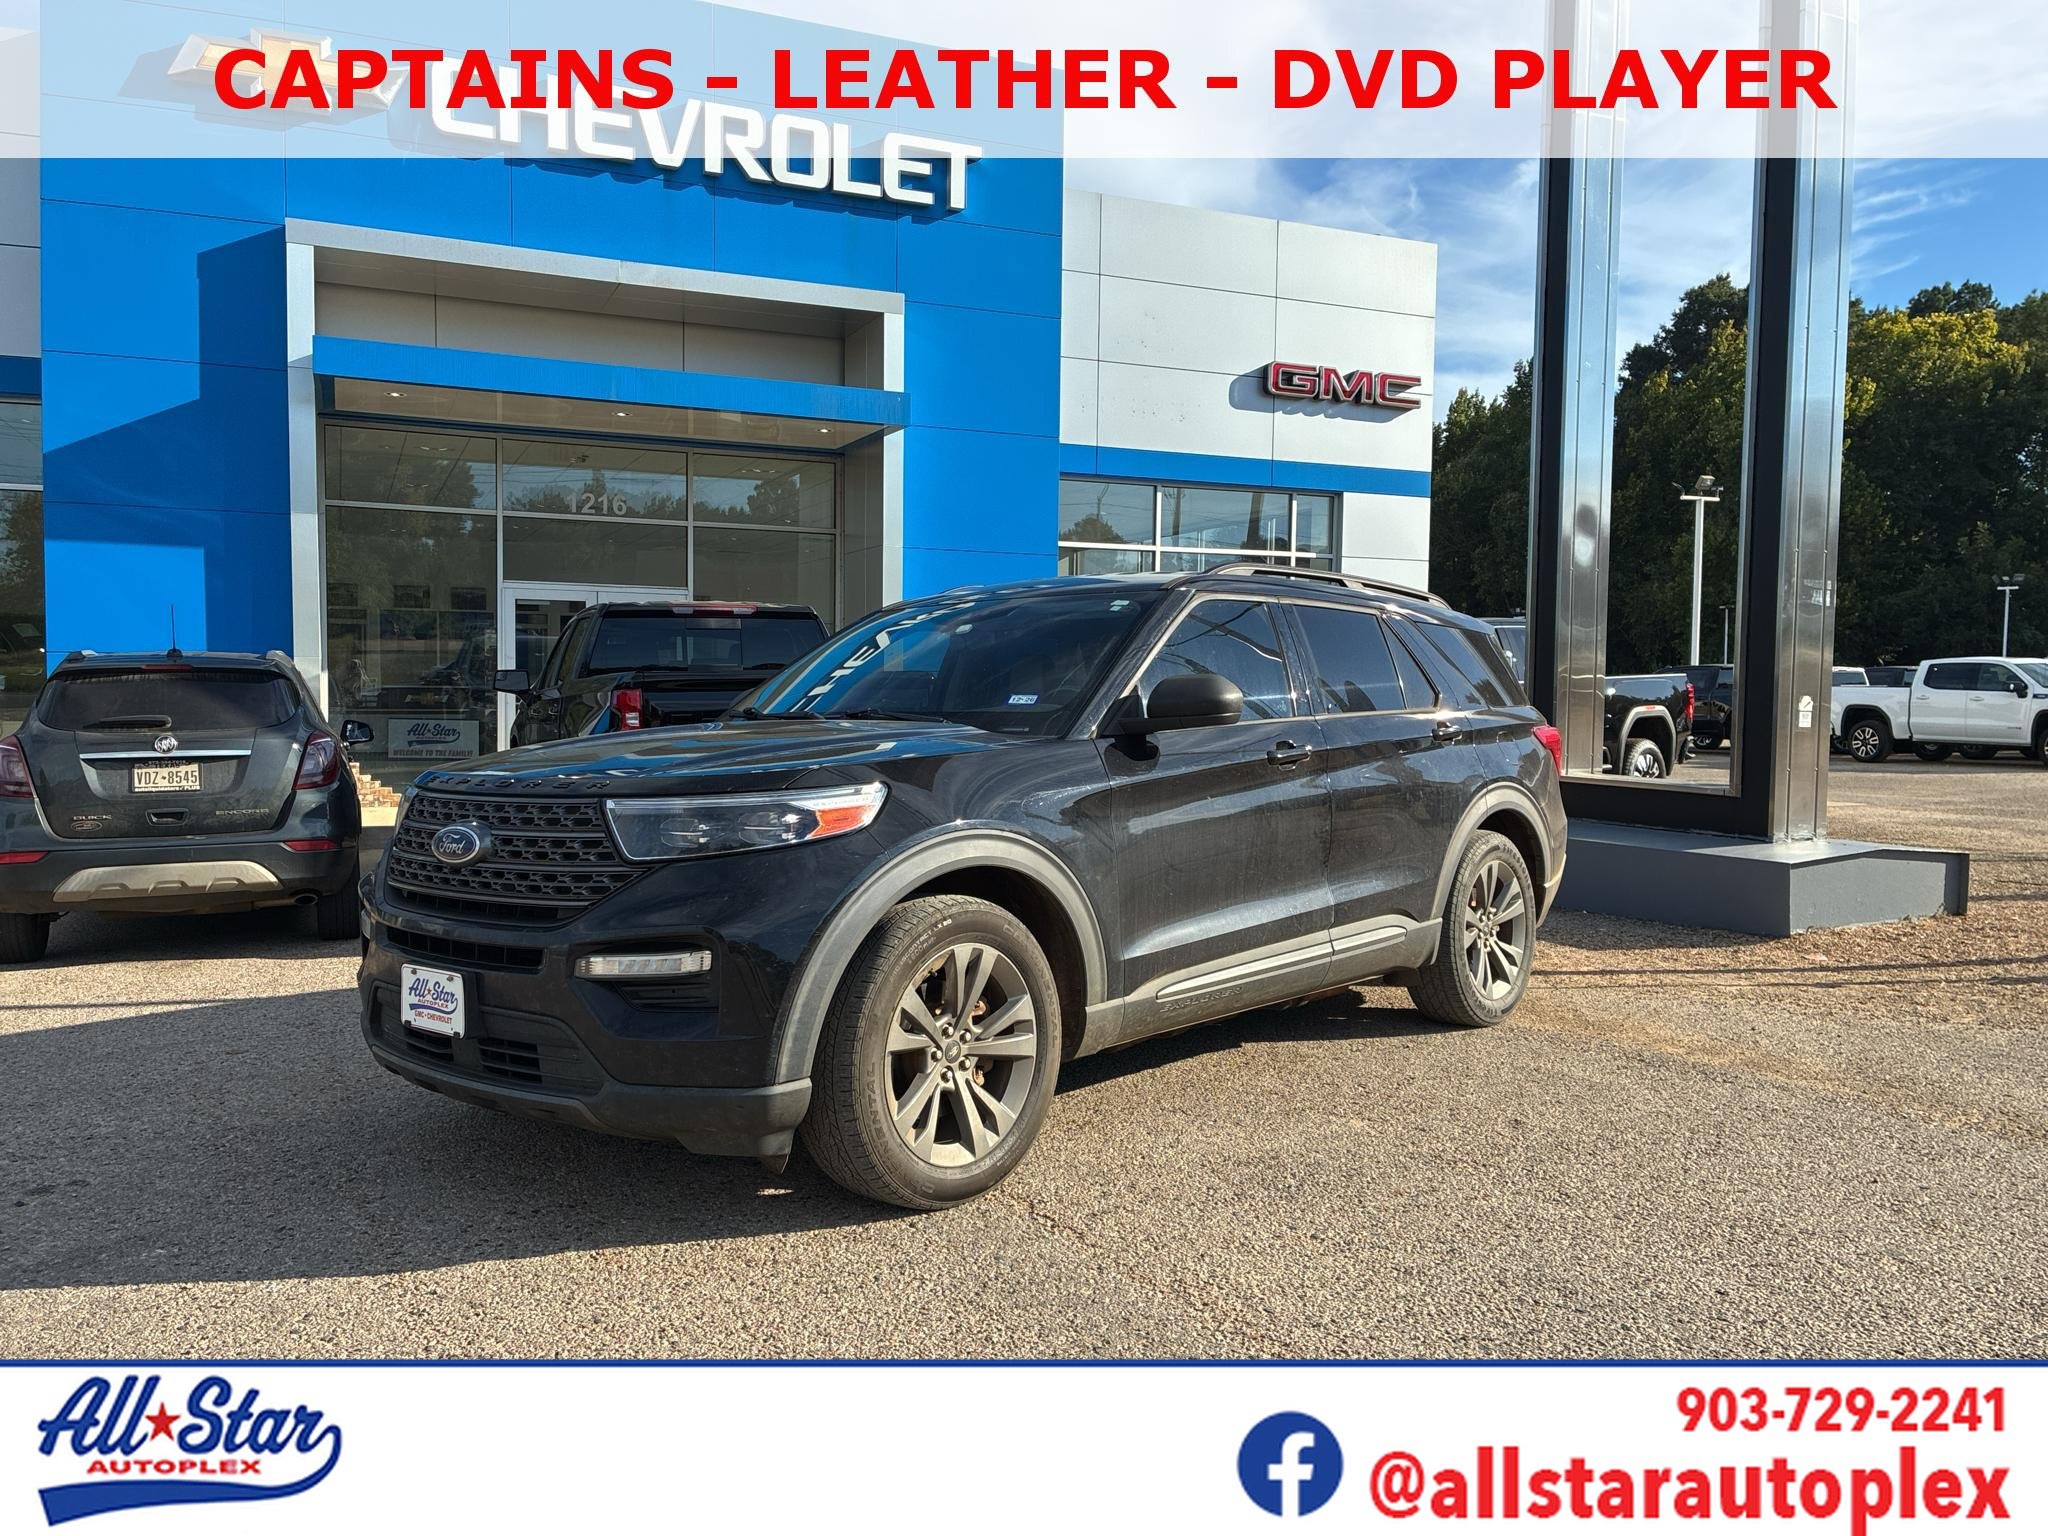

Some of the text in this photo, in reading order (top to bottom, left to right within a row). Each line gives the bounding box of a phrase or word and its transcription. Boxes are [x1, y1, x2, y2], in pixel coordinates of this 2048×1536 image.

[430, 57, 983, 211] CHEVROLET
[1267, 361, 1422, 409] GMC
[564, 492, 627, 515] 1216
[407, 723, 458, 737] All Star
[136, 770, 197, 785] VDZ 8545
[427, 776, 611, 790] EXPLORER
[438, 833, 466, 854] Ford
[408, 977, 456, 1004] All Star
[417, 998, 449, 1009] AUTOPLEX
[415, 1010, 453, 1025] GMC CHEVROLET
